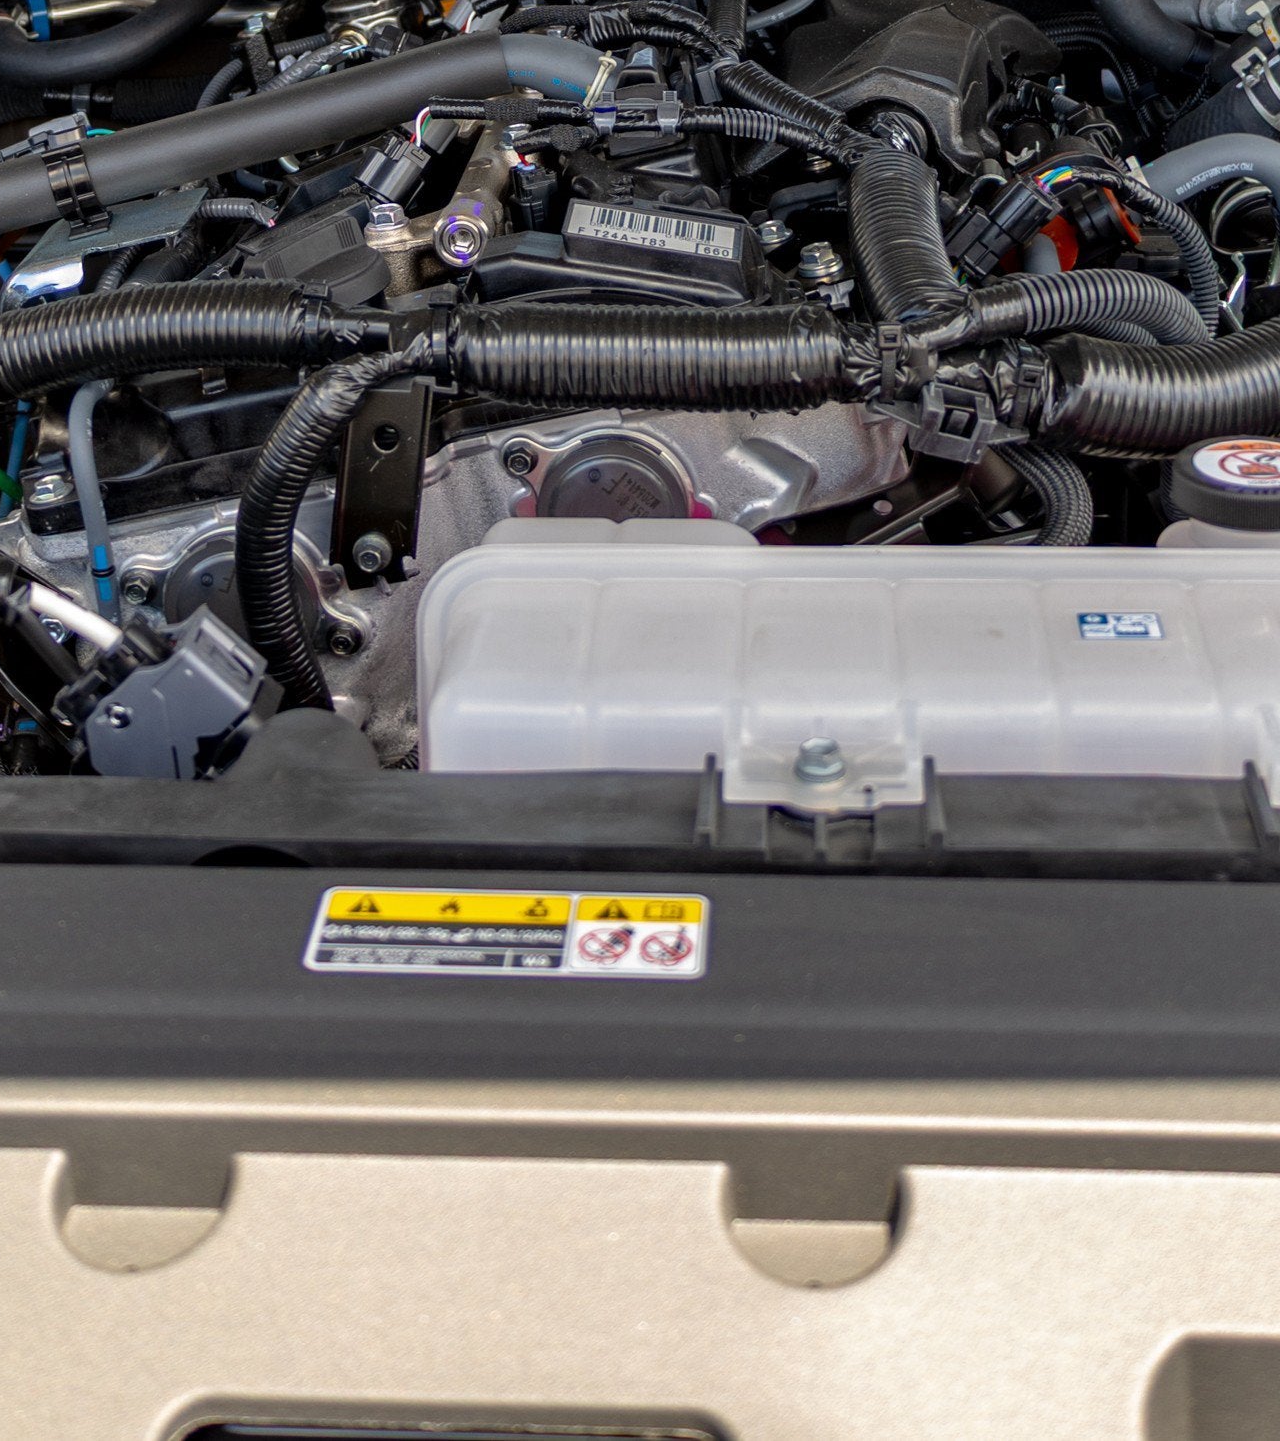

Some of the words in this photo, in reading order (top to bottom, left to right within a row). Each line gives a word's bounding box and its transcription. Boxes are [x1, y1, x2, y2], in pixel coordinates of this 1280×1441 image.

[577, 226, 586, 235] F
[593, 228, 667, 248] T24A-T83
[703, 246, 730, 258] 660
